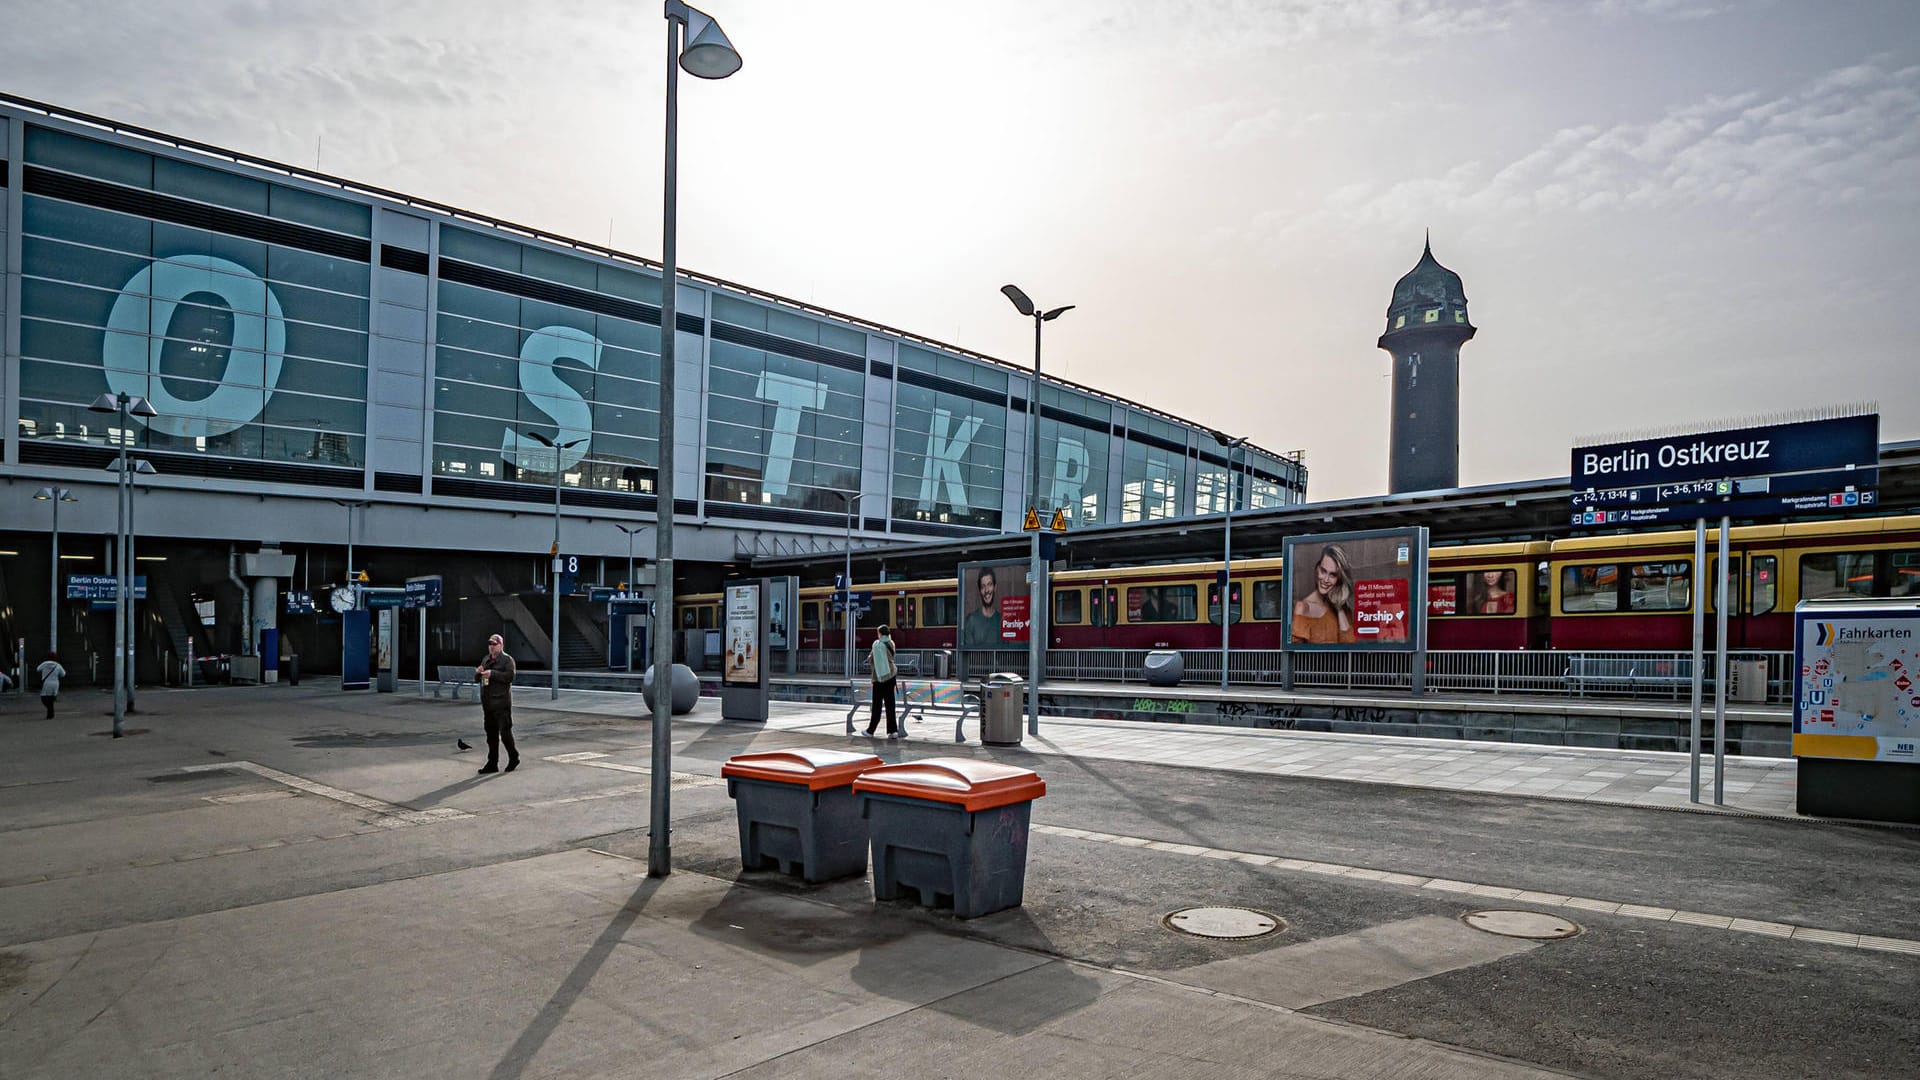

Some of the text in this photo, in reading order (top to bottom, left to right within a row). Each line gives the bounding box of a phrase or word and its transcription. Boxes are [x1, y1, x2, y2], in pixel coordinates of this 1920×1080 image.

[1583, 440, 1770, 475] Berlin Ostkreuz
[1673, 483, 1713, 494] 3-6, 11-12
[1583, 493, 1597, 502] 1-2,
[1608, 490, 1627, 500] 13-14
[568, 556, 578, 573] 8
[70, 576, 92, 584] Berlin
[836, 575, 842, 587] 7
[1357, 610, 1394, 624] Parship
[1002, 618, 1024, 630] Parship
[1840, 626, 1912, 639] Fahrkarten
[1811, 691, 1823, 704] U
